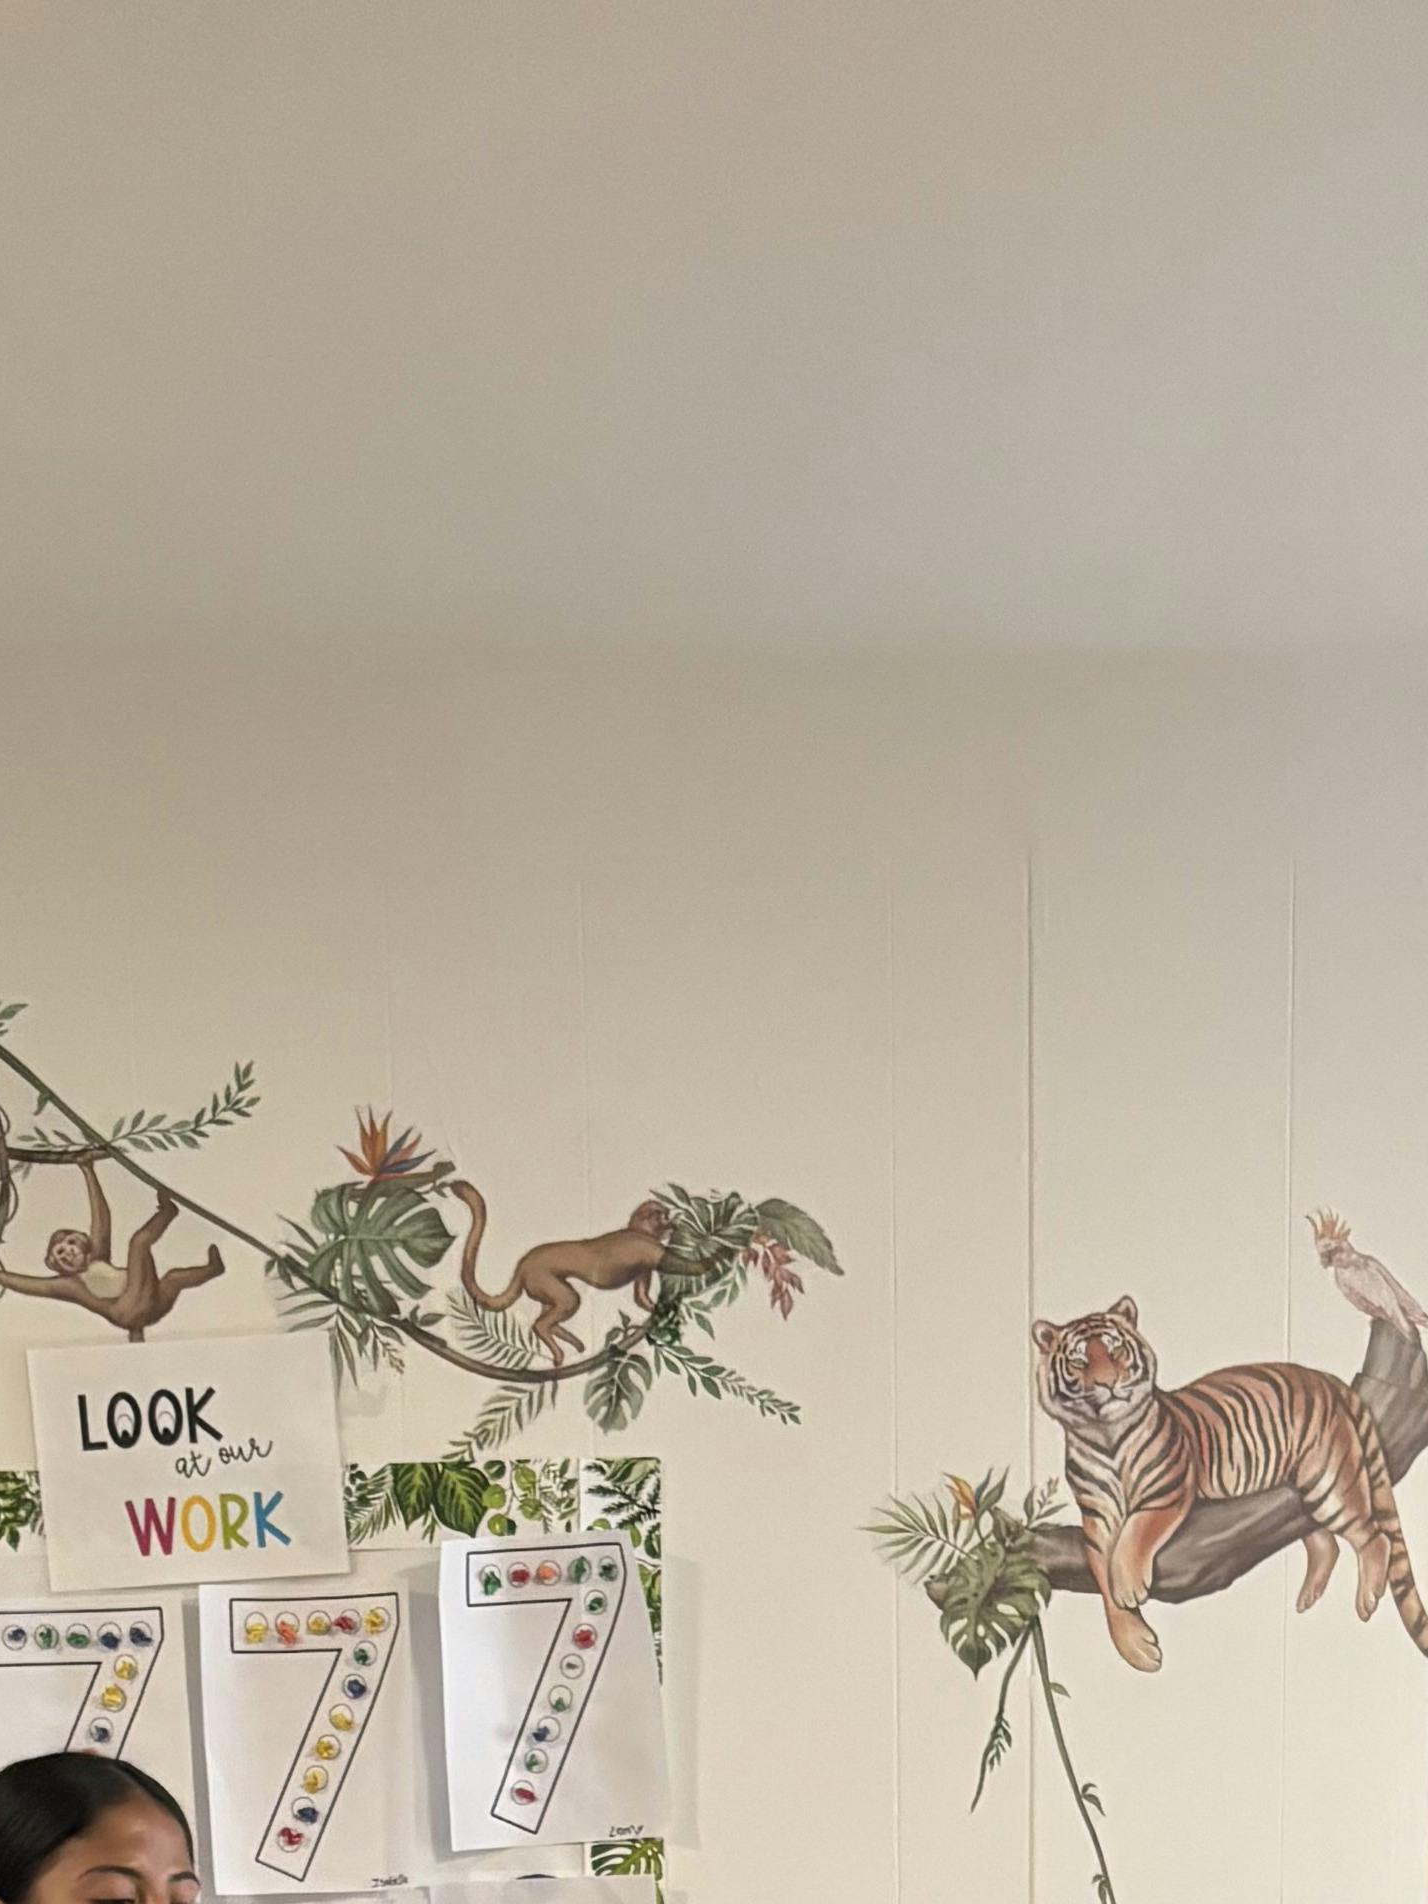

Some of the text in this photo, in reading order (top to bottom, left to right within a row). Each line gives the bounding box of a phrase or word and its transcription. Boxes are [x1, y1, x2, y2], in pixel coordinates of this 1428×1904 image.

[78, 1387, 222, 1451] LOOK
[175, 1438, 273, 1478] at our
[124, 1491, 291, 1556] WORK
